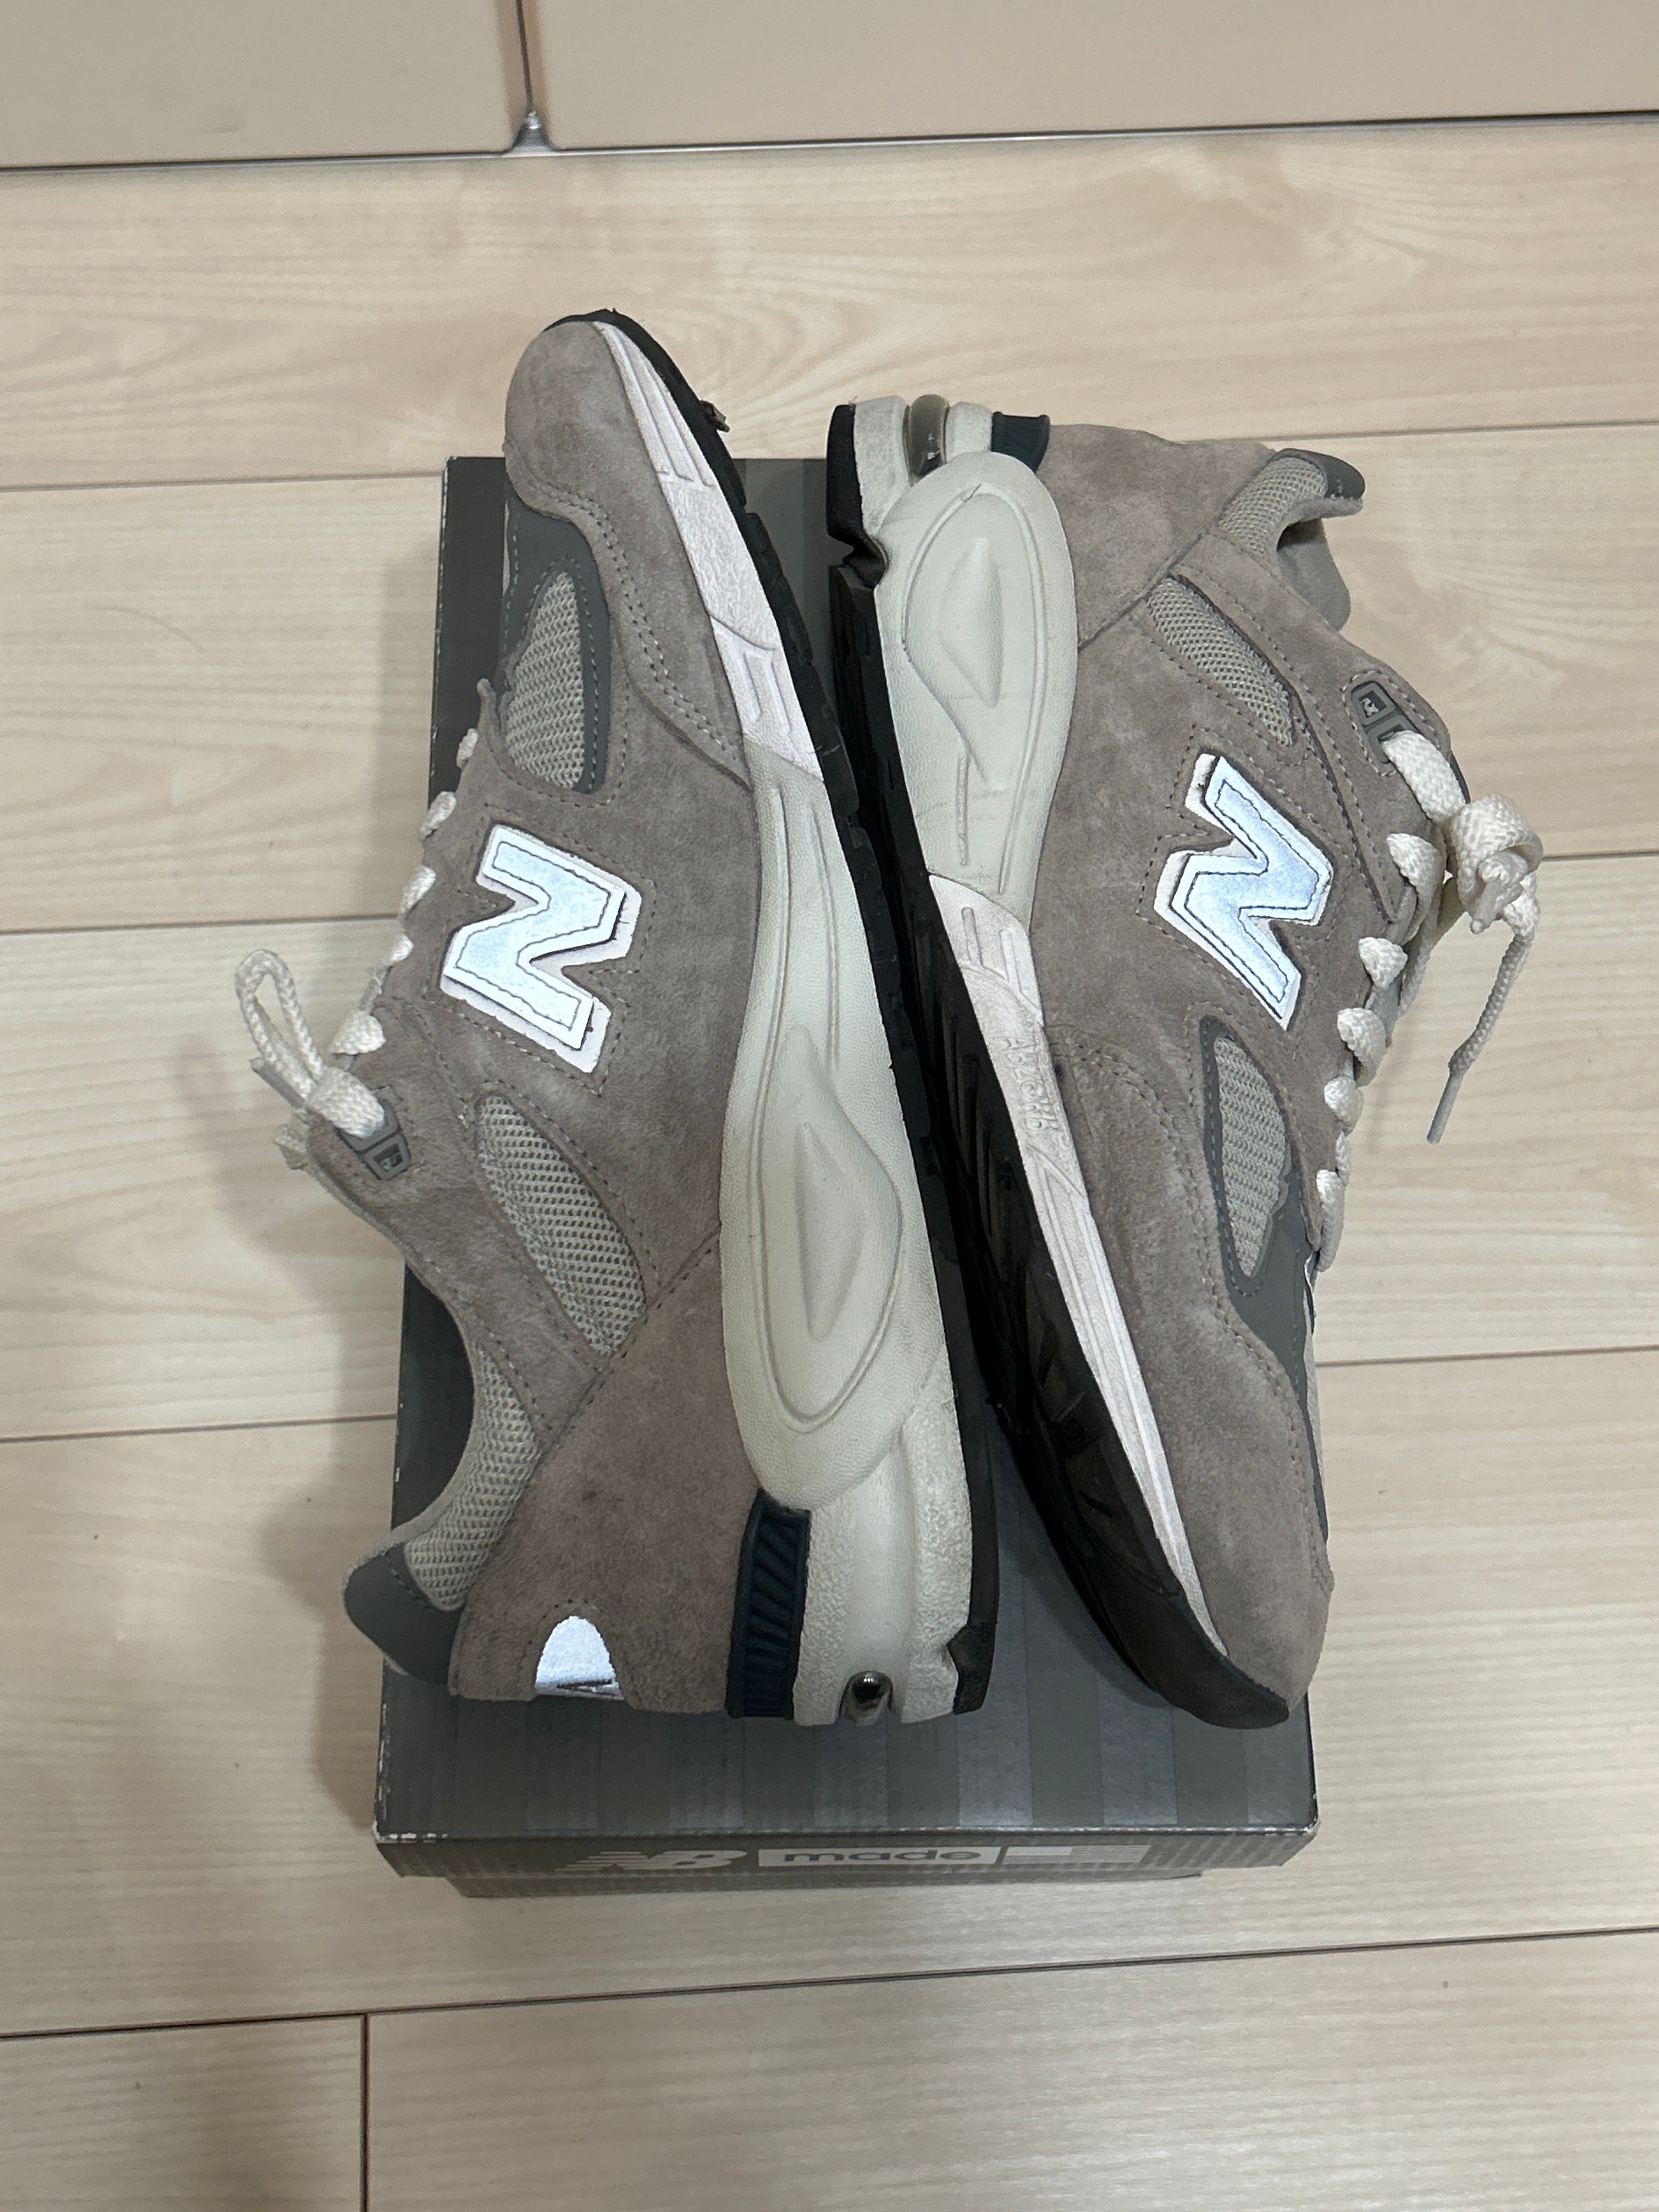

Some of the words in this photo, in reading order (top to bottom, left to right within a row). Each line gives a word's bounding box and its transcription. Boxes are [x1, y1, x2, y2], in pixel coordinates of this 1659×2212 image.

[441, 824, 642, 1073] N
[1154, 753, 1334, 1031] N
[991, 1036, 1064, 1133] ABZORB
[785, 1849, 981, 1861] made
